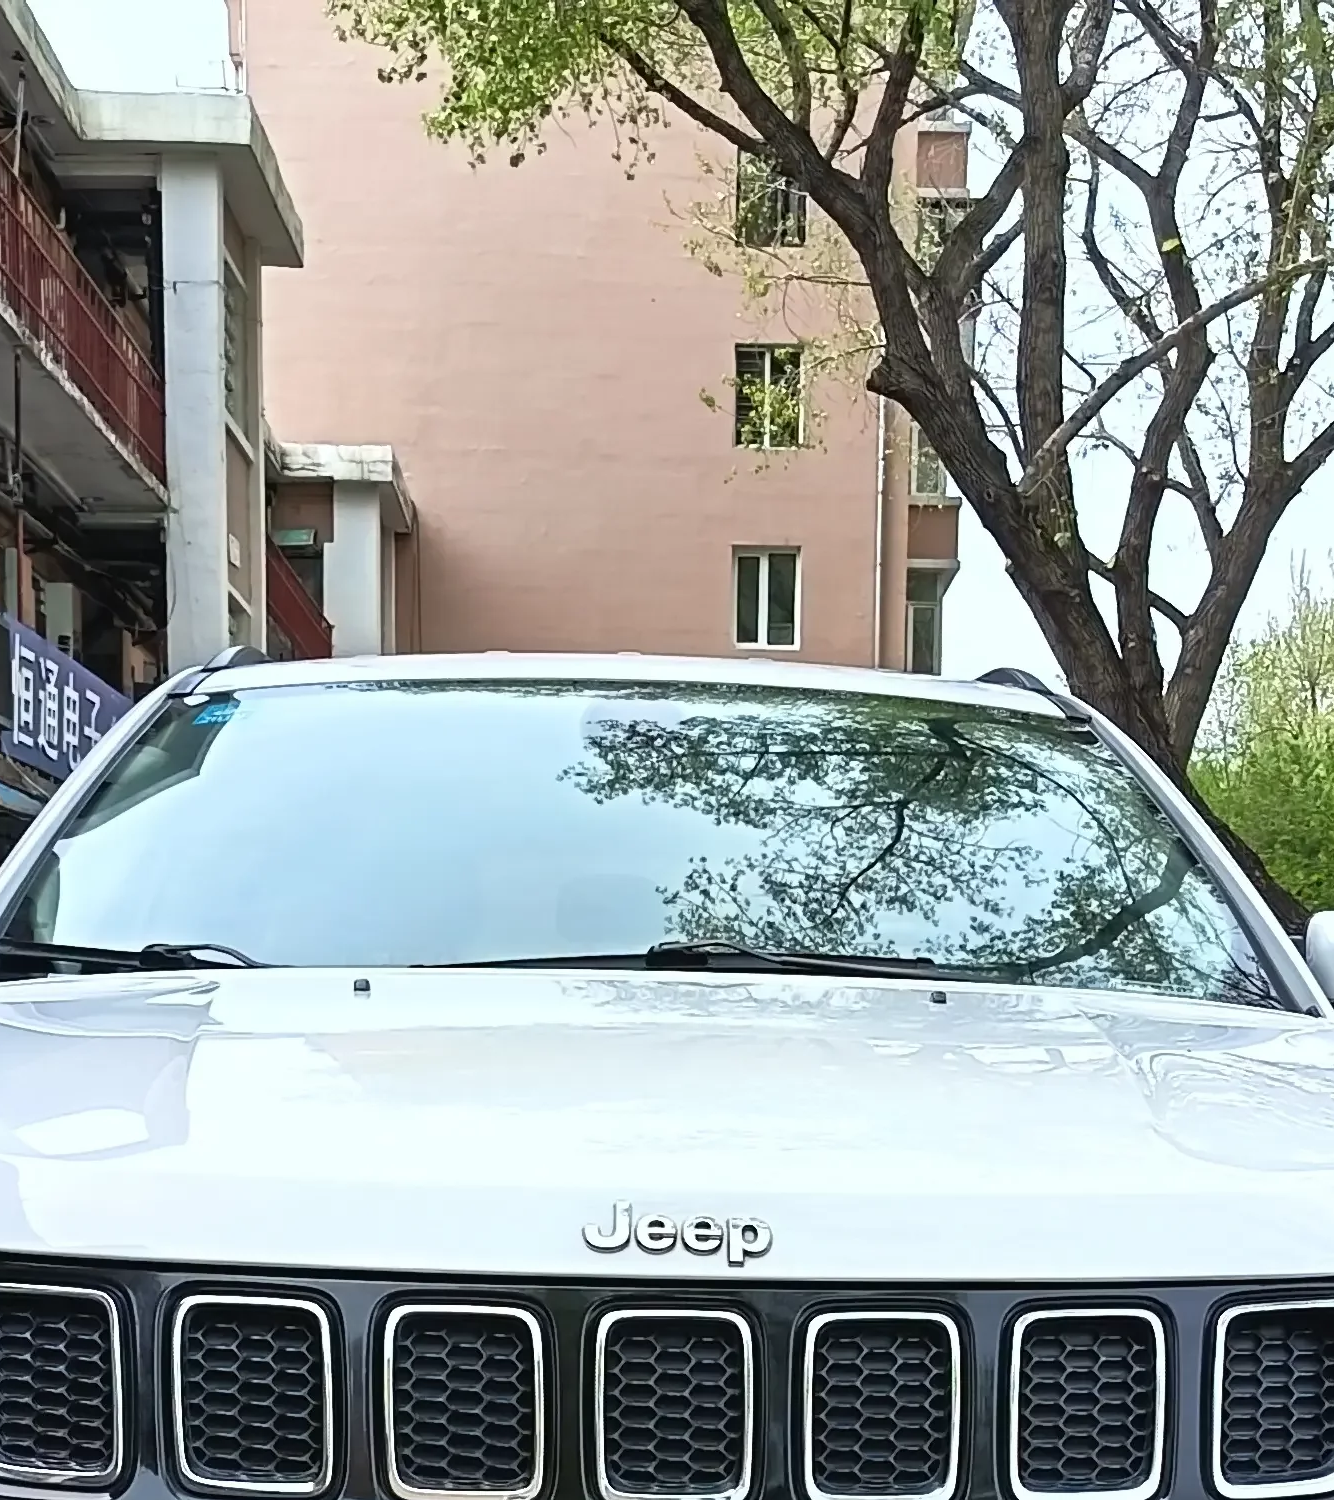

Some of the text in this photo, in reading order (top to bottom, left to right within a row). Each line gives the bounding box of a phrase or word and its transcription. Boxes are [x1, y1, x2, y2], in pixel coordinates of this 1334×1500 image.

[12, 633, 116, 771] 恒通电子
[582, 1199, 773, 1267] Jeep
